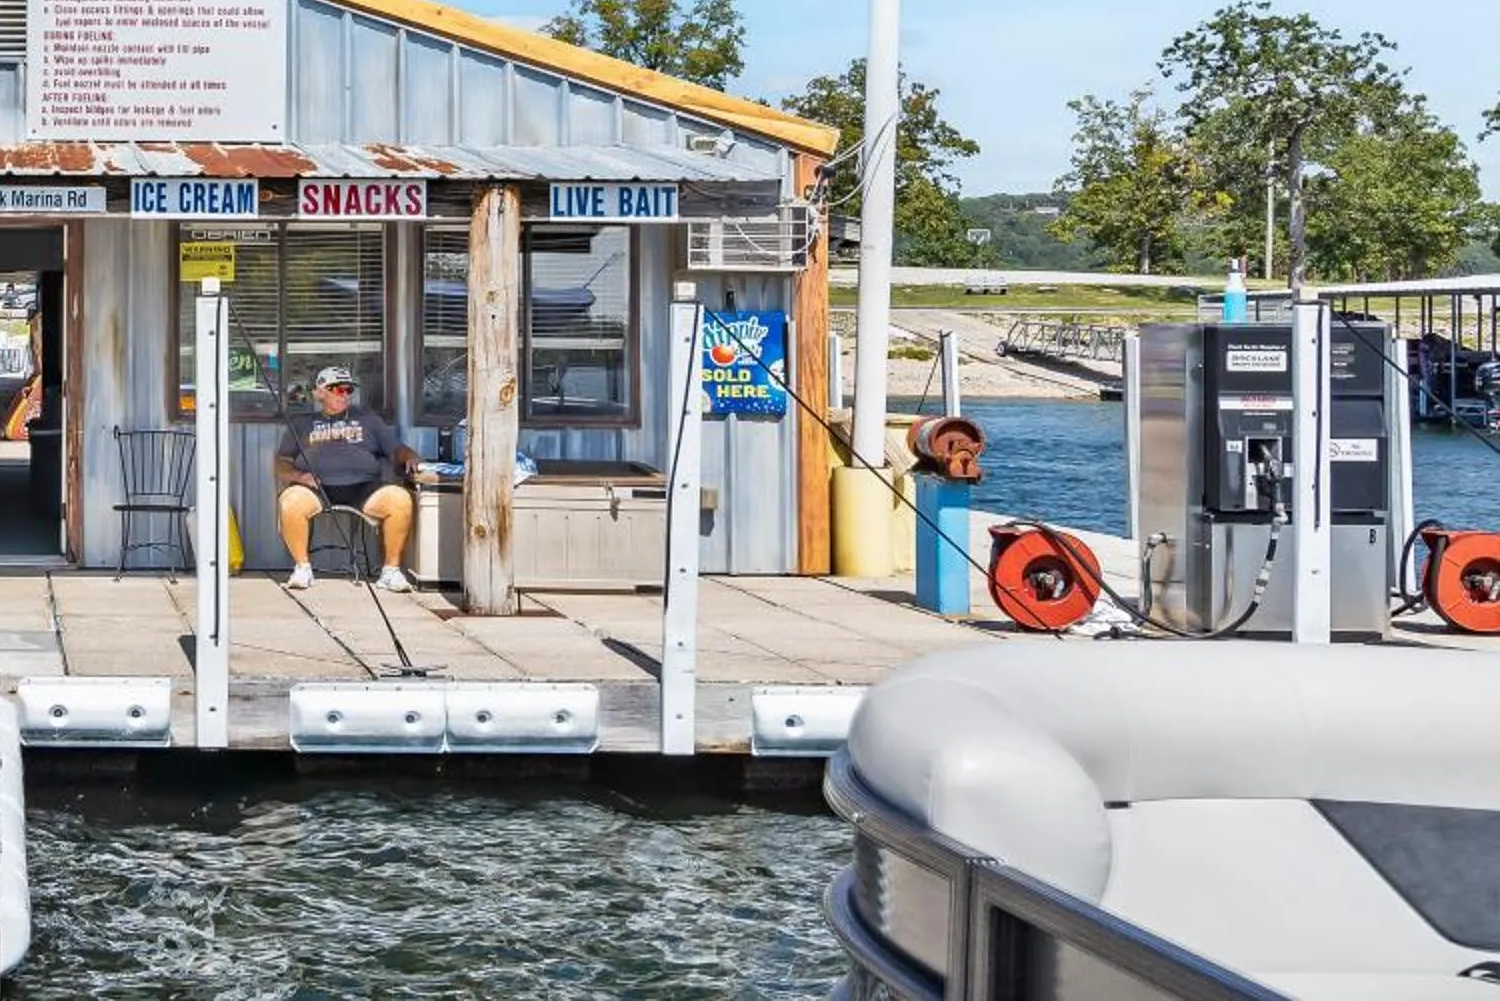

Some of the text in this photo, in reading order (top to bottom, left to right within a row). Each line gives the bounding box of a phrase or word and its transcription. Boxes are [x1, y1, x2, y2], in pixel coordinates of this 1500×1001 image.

[197, 6, 214, 16] that
[218, 7, 240, 16] could
[243, 7, 264, 16] allow
[213, 19, 222, 28] of
[226, 19, 238, 28] the
[44, 31, 75, 40] DURING
[54, 79, 70, 88] Fuel
[42, 93, 69, 102] AFTER
[11, 189, 63, 208] Marina
[68, 190, 88, 208] Rd
[133, 181, 255, 215] ICE CREAM
[302, 183, 423, 216] SNACKS
[551, 186, 677, 218] LIVE BAIT
[699, 368, 752, 382] SOLD
[717, 384, 771, 398] HERE
[1369, 529, 1377, 544] B
